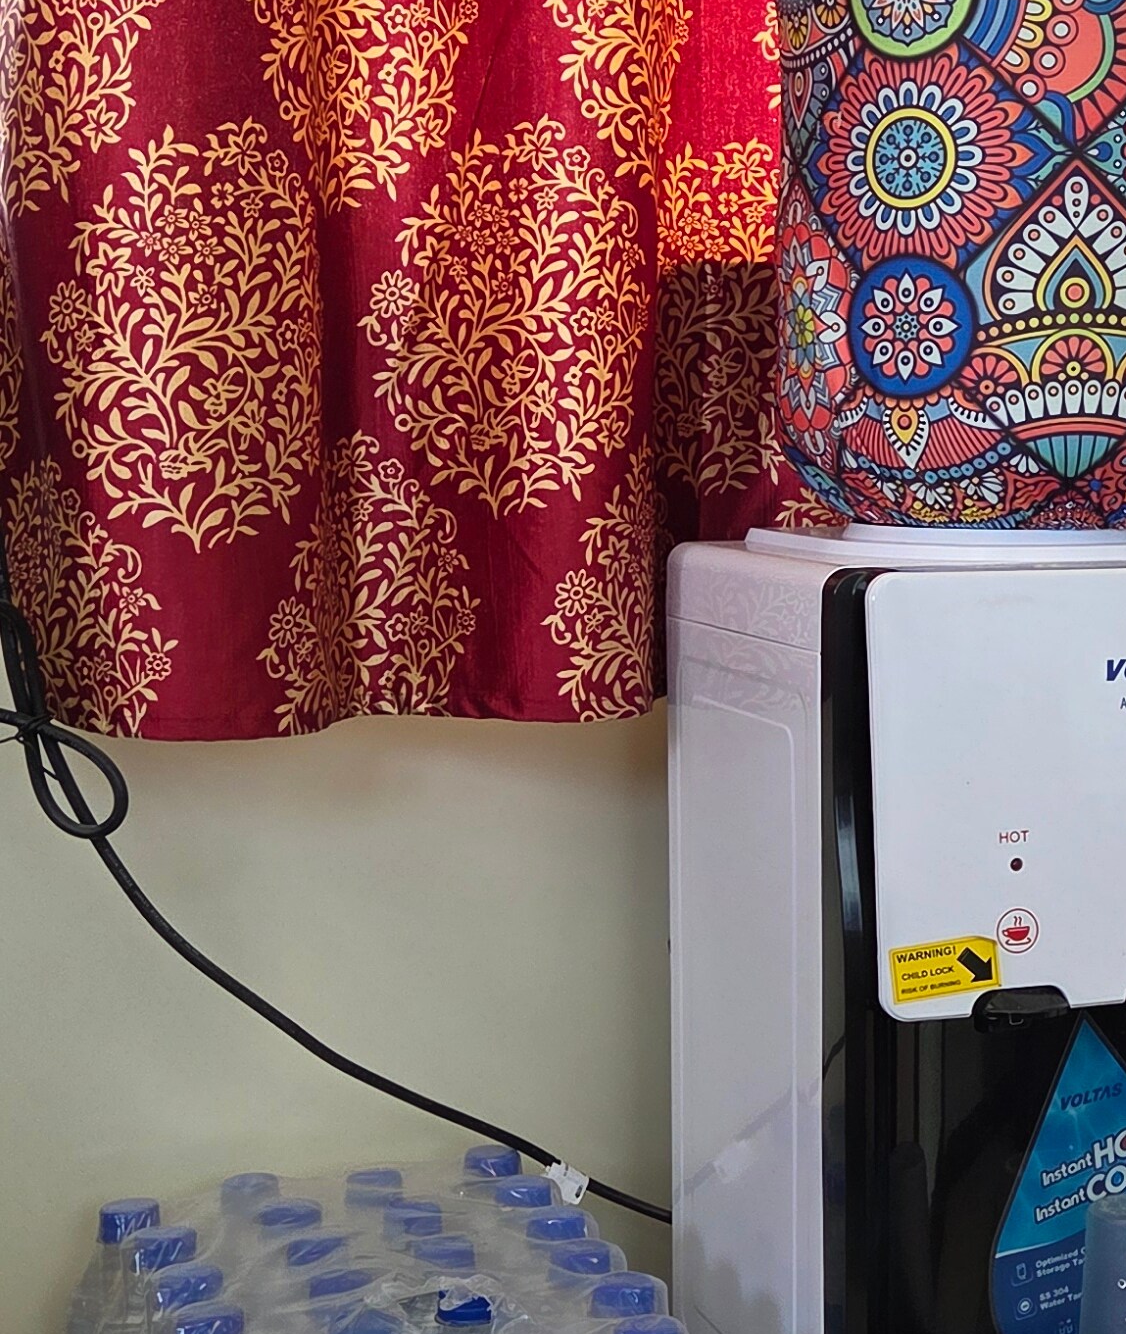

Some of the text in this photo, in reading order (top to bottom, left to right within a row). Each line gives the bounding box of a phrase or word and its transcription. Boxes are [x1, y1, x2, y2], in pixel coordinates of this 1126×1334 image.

[999, 830, 1030, 844] HOT
[896, 946, 956, 963] WARNING!
[902, 966, 955, 981] CHILD LOCK
[1060, 1083, 1123, 1110] VOLTAS
[1042, 1154, 1092, 1186] Instant
[1036, 1189, 1086, 1222] Instant
